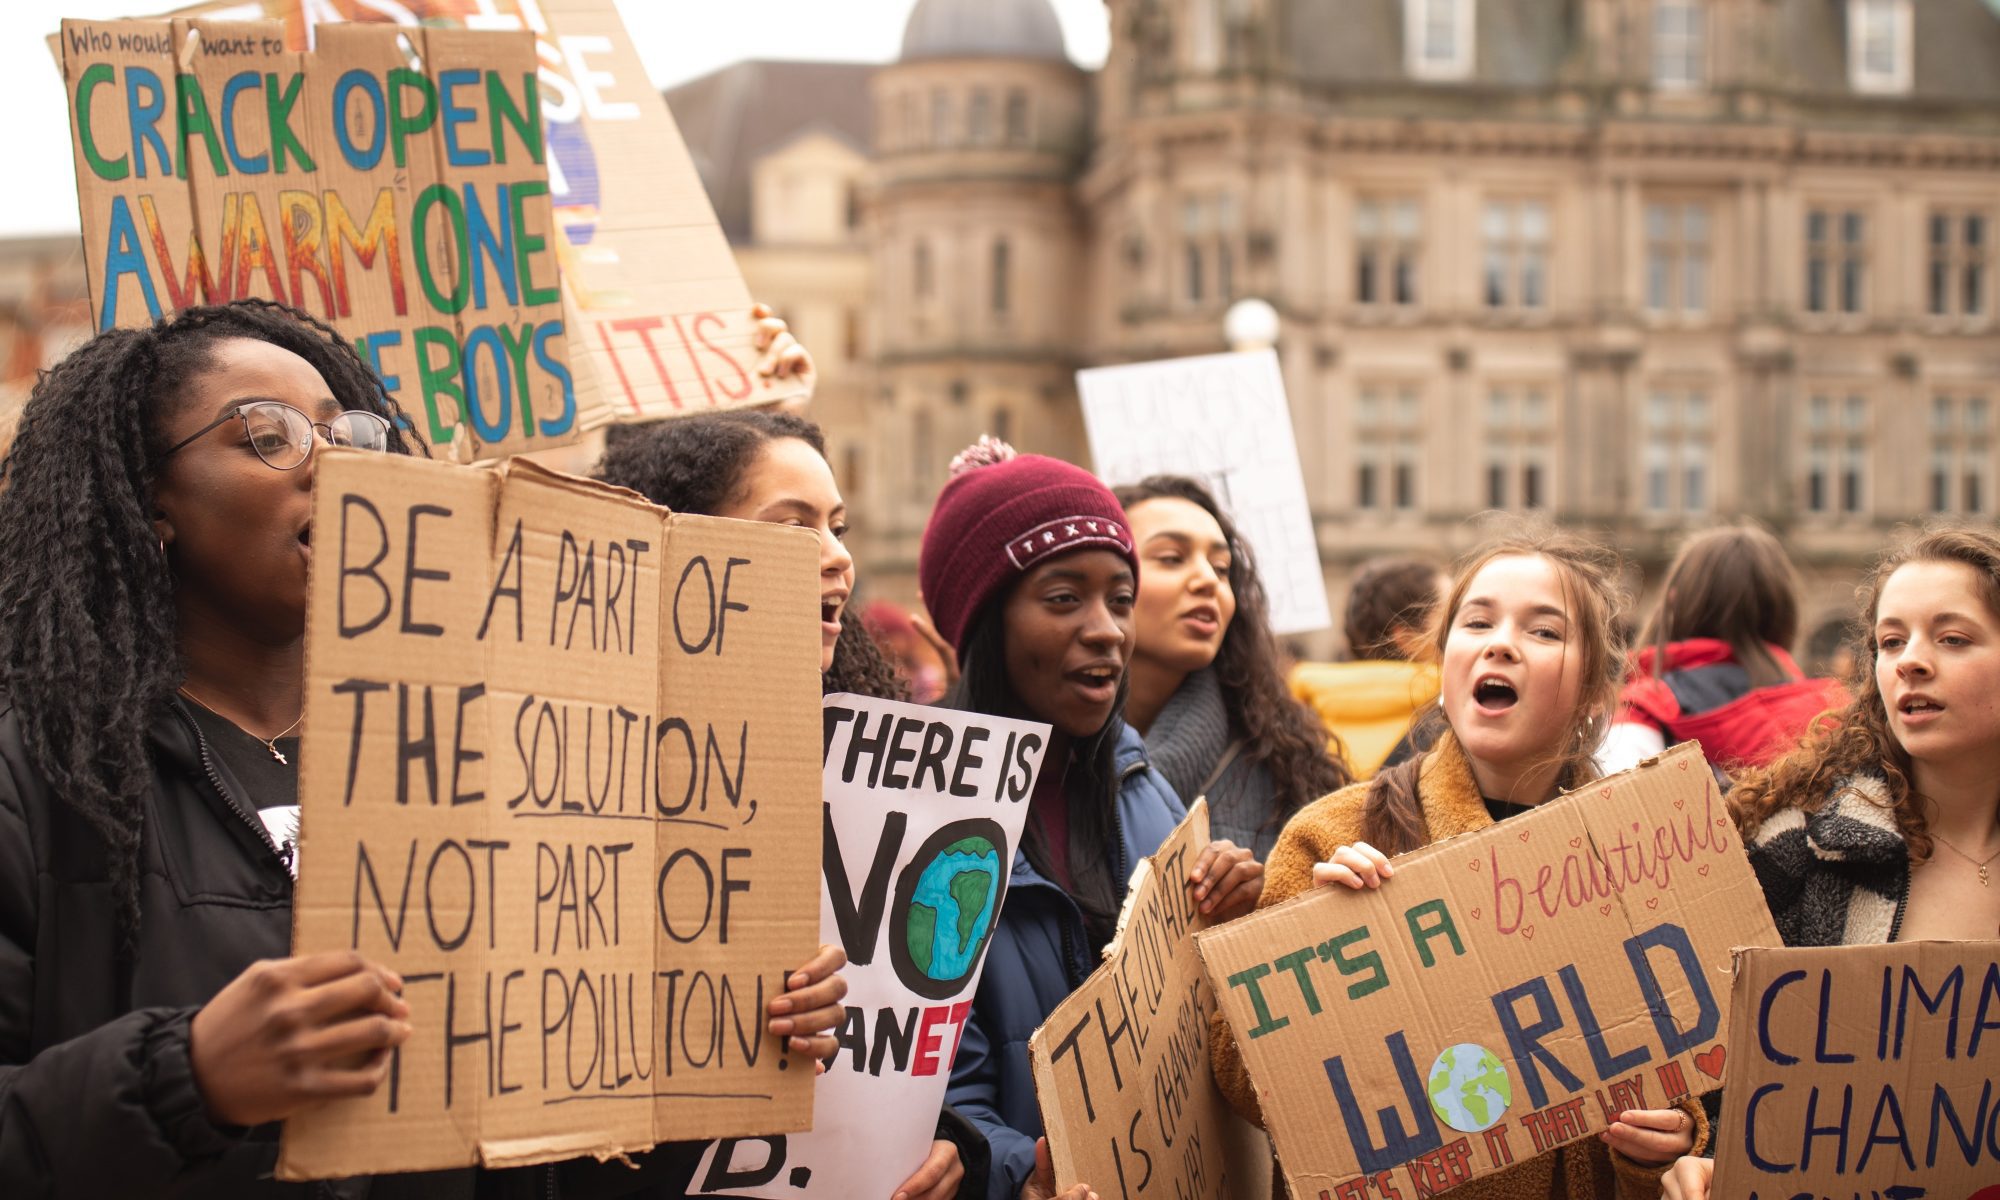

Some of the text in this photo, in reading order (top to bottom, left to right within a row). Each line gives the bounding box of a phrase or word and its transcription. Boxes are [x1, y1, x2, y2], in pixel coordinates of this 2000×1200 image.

[69, 27, 282, 57] Who would want to
[75, 63, 318, 180] CRACK
[332, 68, 545, 170] OPEN
[101, 179, 561, 332] A WARM ONE
[412, 319, 577, 445] BOYS
[597, 318, 683, 416] IT
[337, 493, 752, 657] BE A PART OF
[331, 678, 758, 824] THE SOLUTION,
[822, 706, 1042, 803] THERE IS
[351, 839, 752, 955] NOT PART OF
[1228, 778, 1728, 1039] IT'S A beautiful
[825, 998, 973, 1077] ANET
[1051, 842, 1195, 1124] THE CLIMATE
[1111, 1108, 1152, 1200] IS
[1405, 1136, 1473, 1200] KEEP
[1482, 1123, 1515, 1168] IT
[1520, 1096, 1589, 1154] THAT
[1595, 1073, 1648, 1125] WAY
